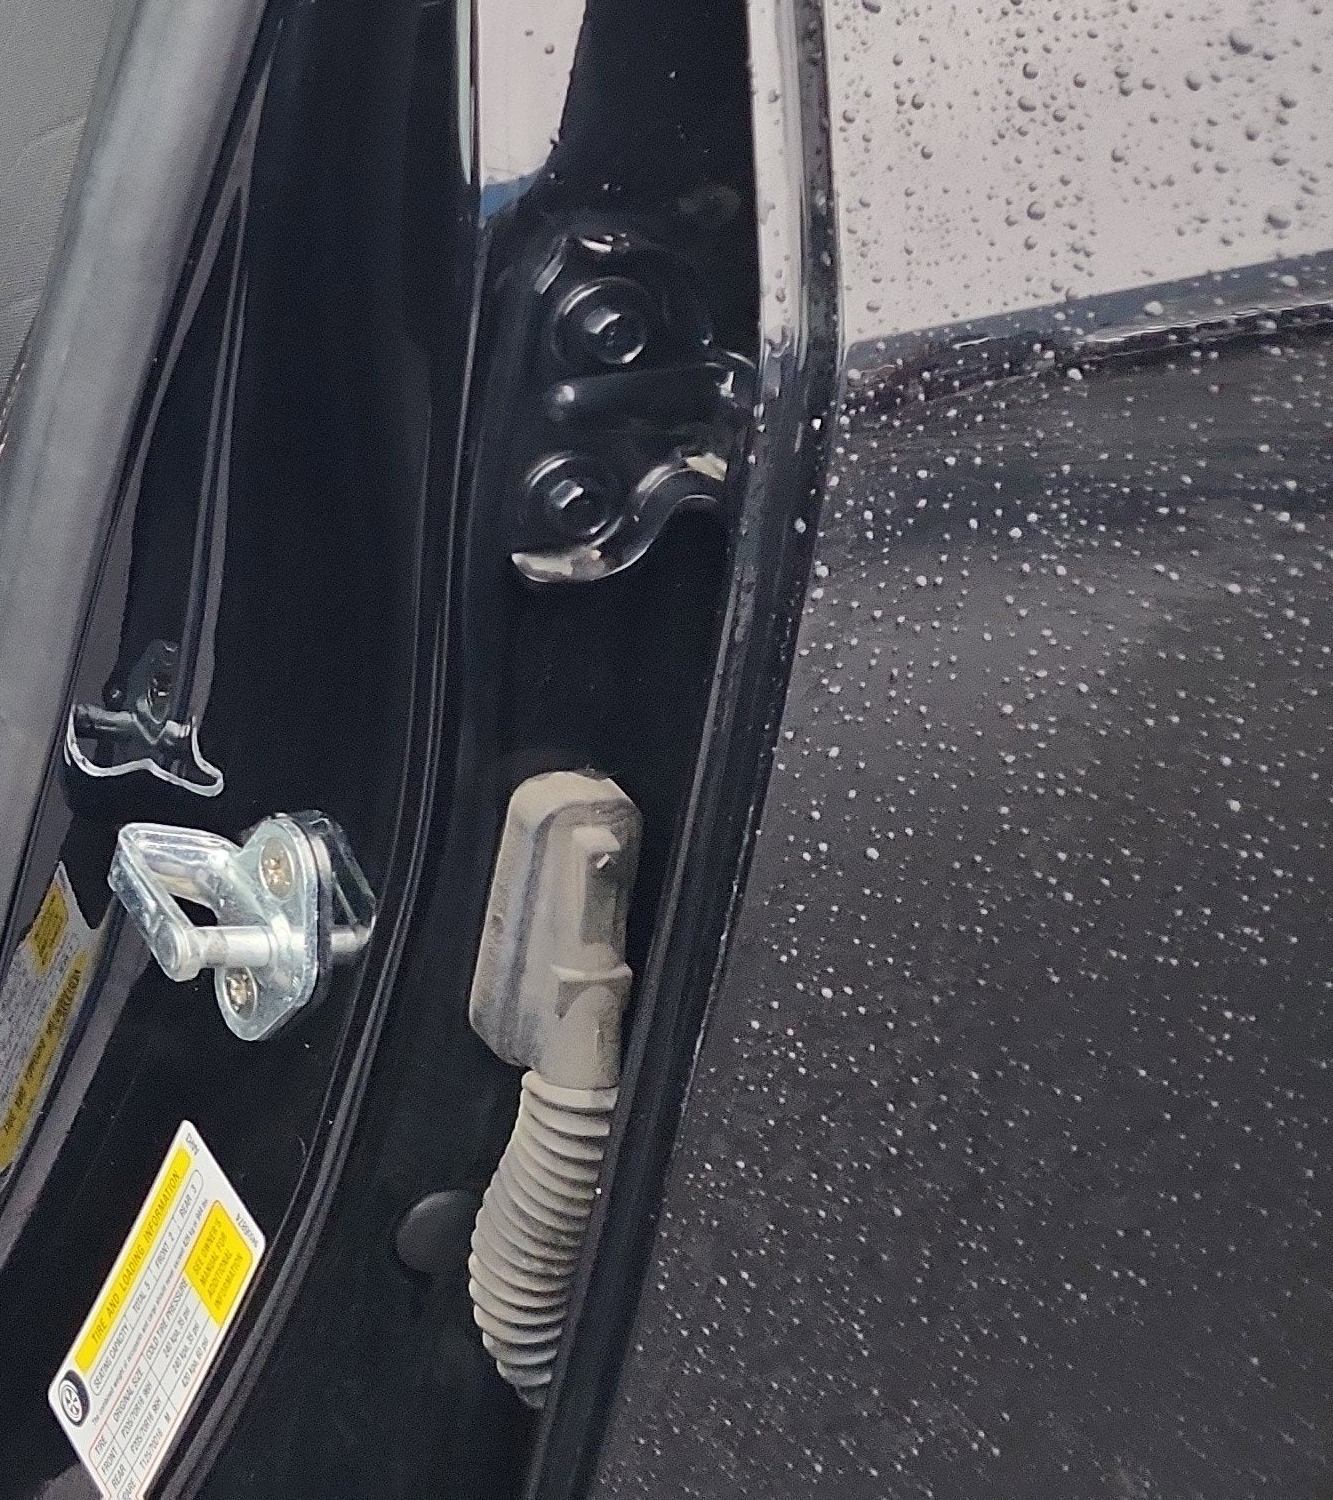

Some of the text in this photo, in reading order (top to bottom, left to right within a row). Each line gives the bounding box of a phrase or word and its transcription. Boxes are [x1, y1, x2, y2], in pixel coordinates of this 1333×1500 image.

[91, 1169, 181, 1345] TIRE AND LOADING INFORMATION
[191, 1254, 203, 1276] SEE
[198, 1229, 228, 1287] MANUAL FOR
[205, 1246, 233, 1299] ADDITIONAL
[212, 1250, 244, 1311] INFORMATION
[93, 1355, 112, 1390] SEATING
[108, 1320, 129, 1359] CAPACITY
[132, 1288, 146, 1314] TOTAL
[154, 1241, 169, 1269] FRONT
[178, 1193, 193, 1219] REAR
[144, 1276, 188, 1361] COLD TIRE PRESSURE
[112, 1364, 144, 1424] ORIGINAL SIZE
[94, 1433, 107, 1457] TIRE
[101, 1445, 118, 1476] FRONT
[110, 1462, 126, 1490] REAR
